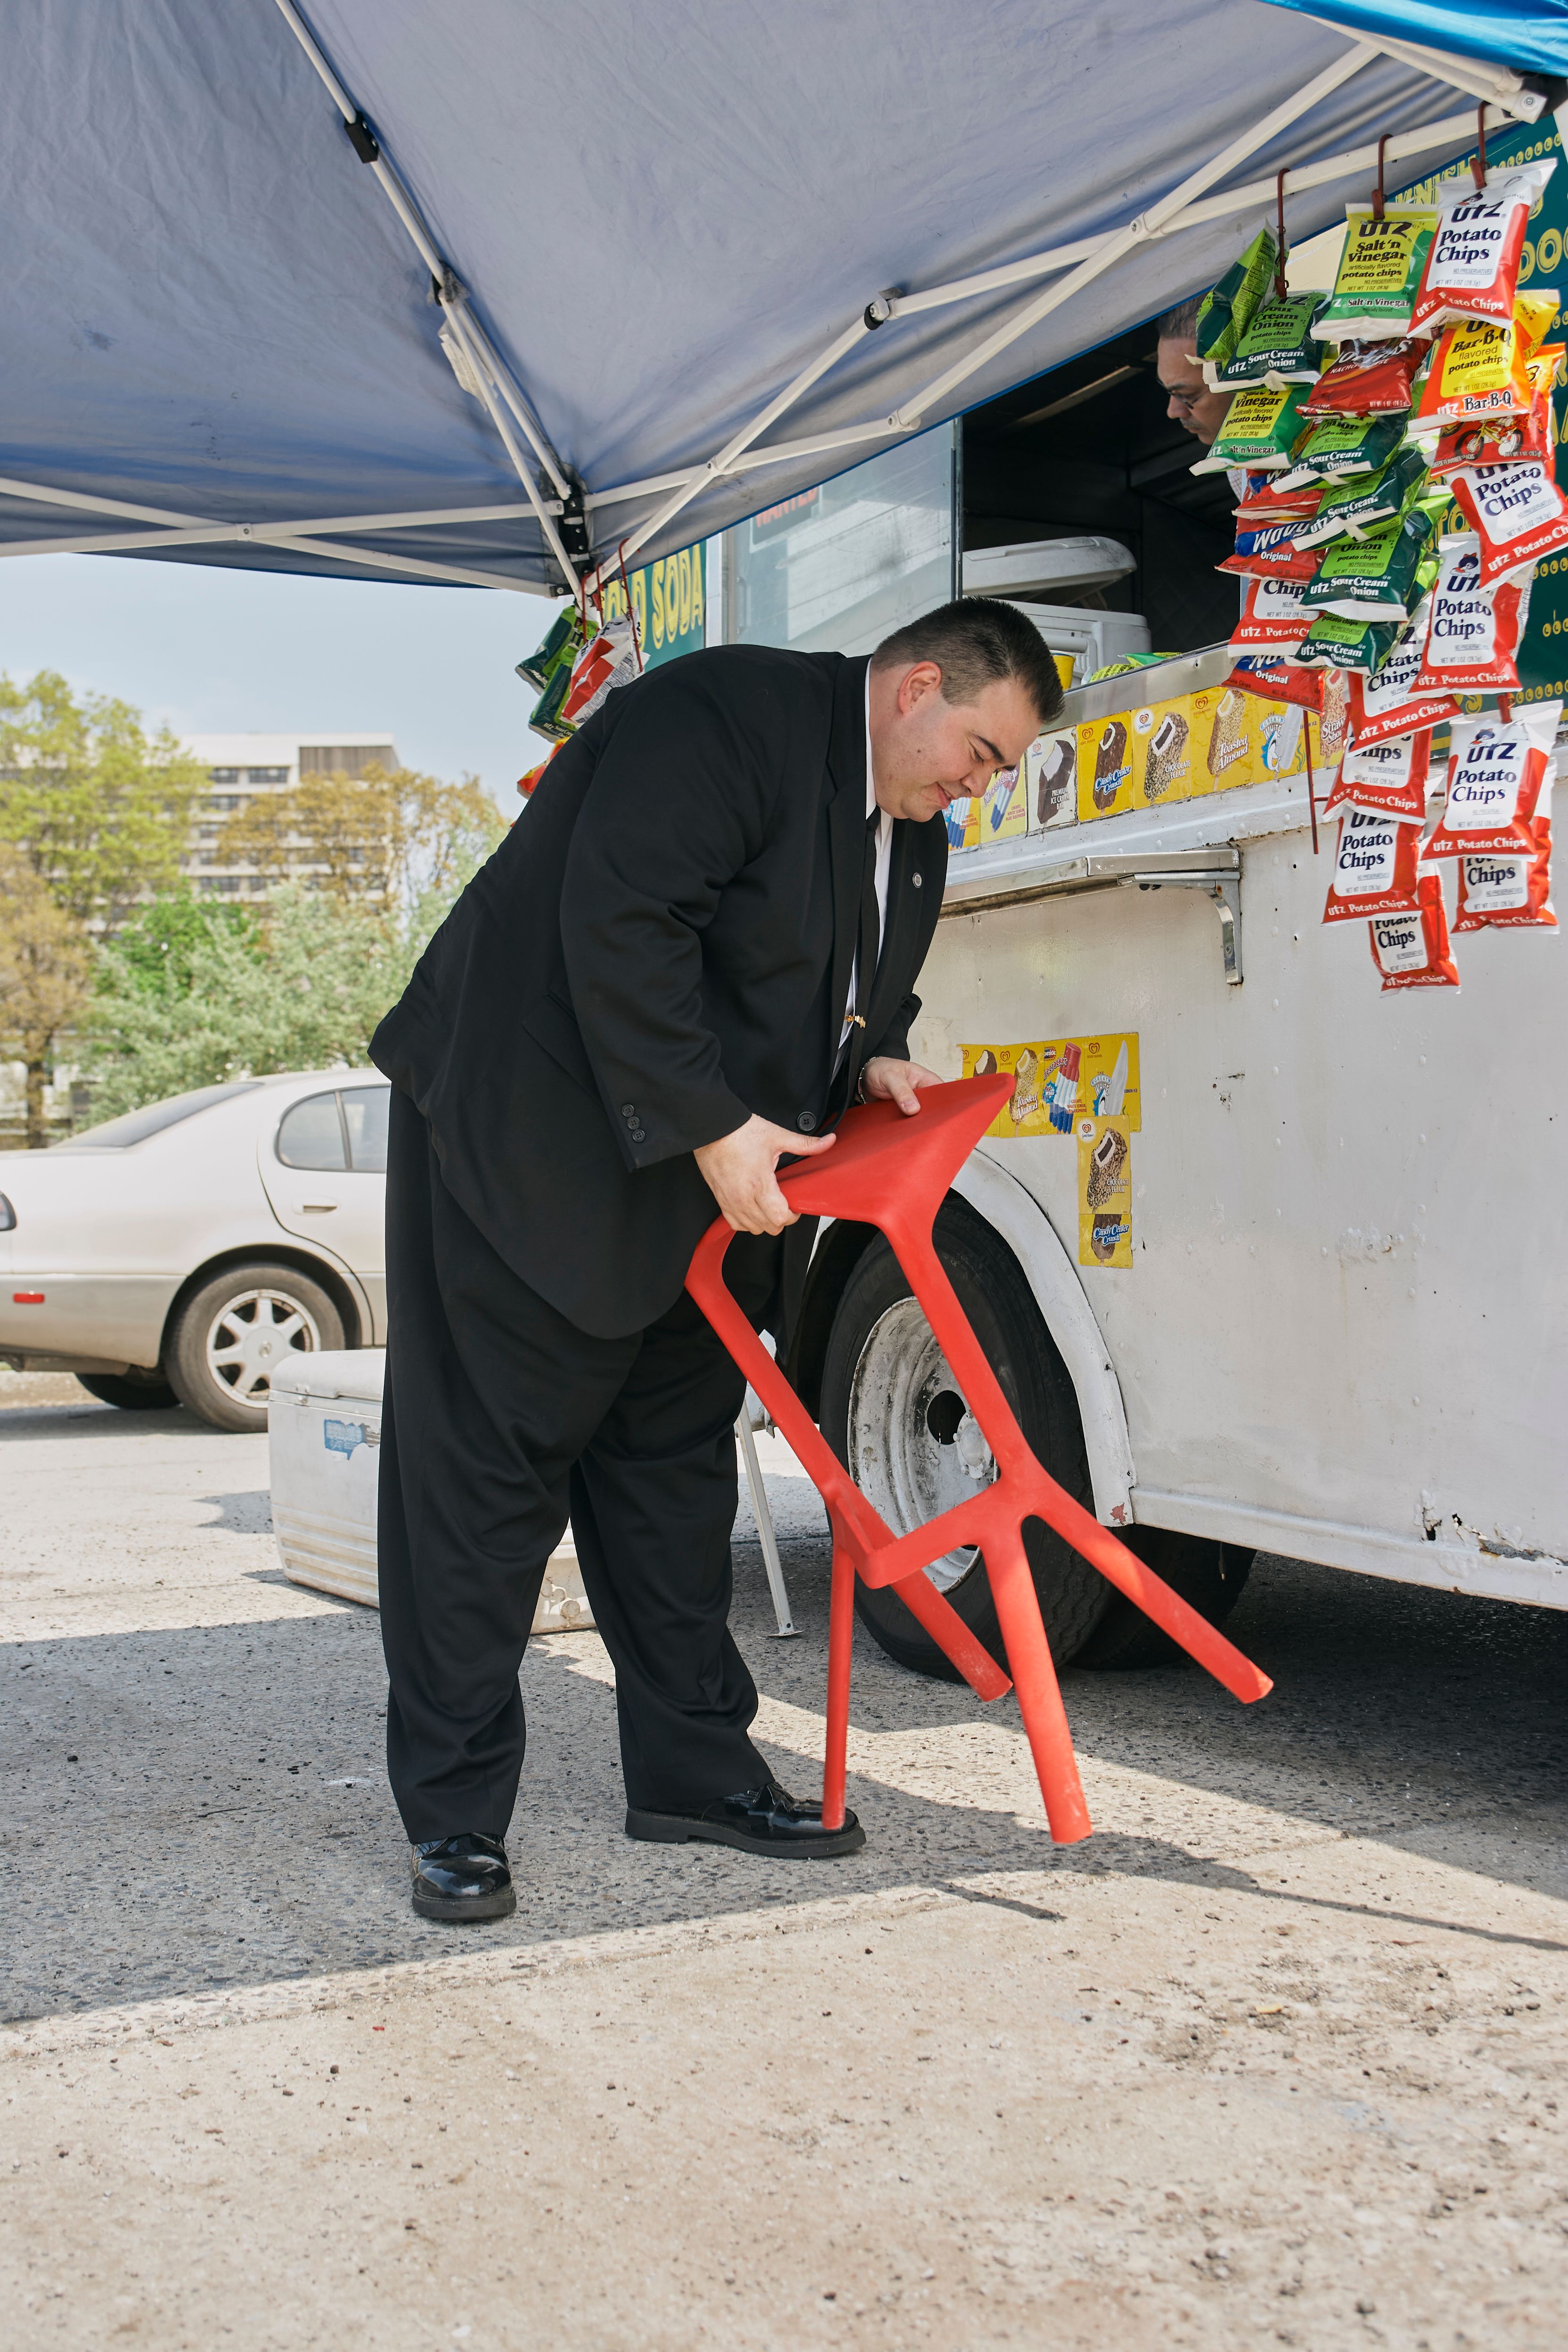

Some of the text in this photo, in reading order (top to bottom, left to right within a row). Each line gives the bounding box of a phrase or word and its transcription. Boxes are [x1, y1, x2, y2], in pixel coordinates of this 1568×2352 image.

[1437, 228, 1502, 248] Potato
[1356, 239, 1385, 254] Salt
[1348, 252, 1407, 268] Vinegar
[1435, 246, 1490, 269] Chips
[1341, 269, 1402, 280] potato chips
[1348, 262, 1400, 275] artificially flavored
[1374, 299, 1411, 309] Vinegar
[1470, 298, 1504, 312] Chips
[1254, 312, 1298, 323] Cream
[1253, 320, 1294, 331] Onion
[1250, 332, 1273, 342] potato
[1248, 350, 1304, 365] Sour Cream
[1459, 345, 1498, 361] flavored
[1267, 357, 1296, 369] Onion
[1448, 356, 1509, 376] potato chips
[1234, 396, 1282, 409] Vinegar
[1253, 407, 1274, 415] flavored
[1225, 414, 1272, 428] potato chips
[1247, 446, 1275, 456] Vinegar
[1308, 450, 1363, 466] Sour Cream
[1474, 467, 1542, 503] Potato
[1484, 482, 1543, 517] Chips
[1253, 523, 1310, 553] Wavy
[1340, 542, 1382, 553] Onion
[1512, 535, 1550, 558] Potato
[1260, 551, 1292, 563] Original
[1331, 577, 1388, 588] Sour Cream
[652, 543, 704, 649] SODA
[1350, 586, 1379, 596] Onion
[1435, 599, 1492, 617] Potato
[1340, 618, 1359, 626] chips
[1434, 618, 1485, 640] Chips
[1265, 627, 1298, 637] Potato
[1315, 641, 1363, 657] Sour Cream
[1330, 653, 1355, 666] Onion
[1255, 670, 1289, 685] Original
[1367, 668, 1420, 693] Chips
[1440, 674, 1476, 685] Potato
[1477, 672, 1510, 683] Chips
[1264, 717, 1281, 727] GREAT
[1381, 712, 1418, 732] Potato
[1418, 702, 1451, 717] Chips
[1263, 724, 1282, 742] WHITE
[1218, 733, 1249, 758] Toasted
[1165, 760, 1191, 773] CHOCOLATE
[1216, 746, 1250, 772] Almond
[1095, 766, 1131, 791] Candy Center
[1170, 769, 1186, 780] ECLAIR
[1454, 769, 1517, 786] Potato
[1103, 779, 1122, 795] Crunch
[1353, 790, 1418, 810] Potato Chips
[1452, 786, 1506, 805] Chips
[1340, 833, 1393, 852] Potato
[1457, 839, 1494, 850] Potato
[1493, 837, 1527, 849] Chips
[1339, 851, 1385, 871] Chips
[1467, 865, 1516, 886] Chips
[1348, 903, 1380, 914] Potato
[1379, 899, 1408, 908] Chips
[1378, 930, 1416, 949] Chips
[1422, 975, 1446, 984] Chips
[1094, 1082, 1110, 1097] WHITE
[1016, 1092, 1038, 1108] Toasted
[1016, 1100, 1038, 1120] Almond
[1106, 1178, 1130, 1187] CHOCOLATE
[1093, 1224, 1129, 1240] Candy Center
[1102, 1233, 1121, 1247] Crunch
